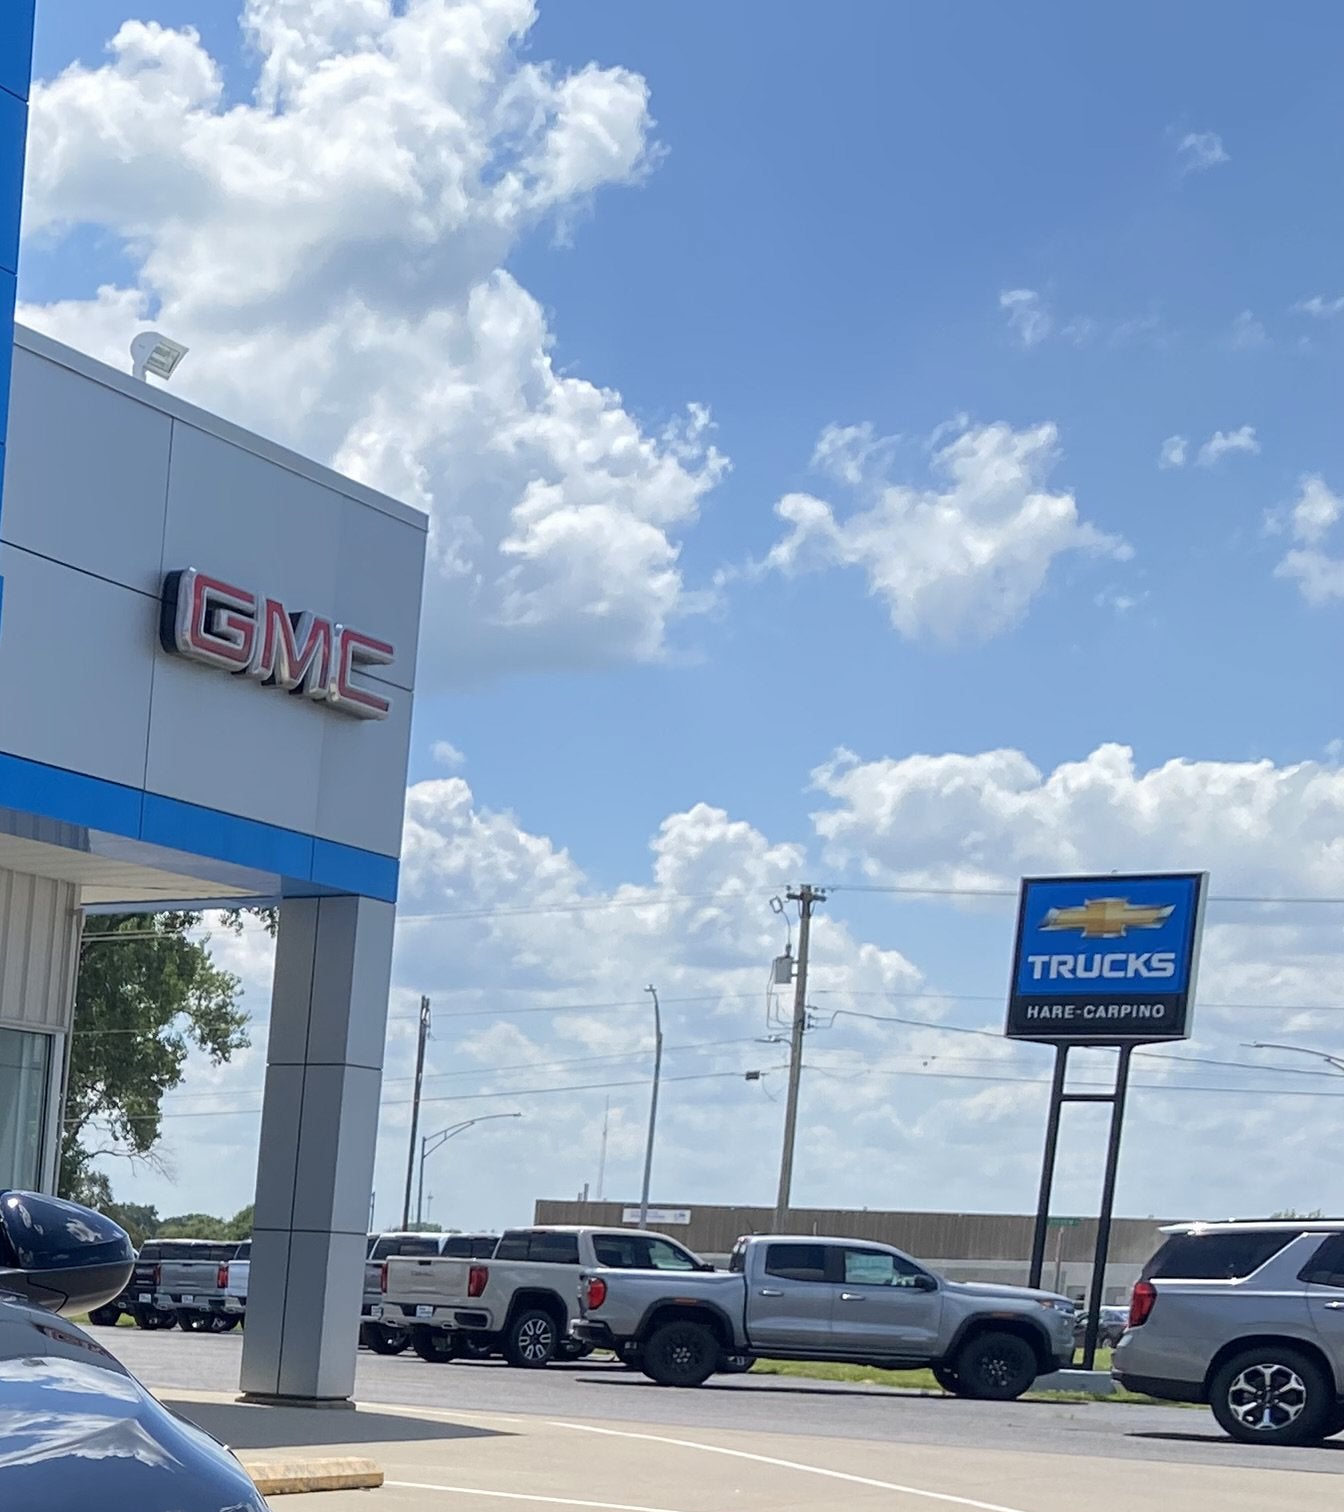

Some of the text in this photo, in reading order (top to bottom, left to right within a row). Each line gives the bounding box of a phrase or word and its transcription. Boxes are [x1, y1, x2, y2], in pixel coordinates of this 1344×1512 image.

[162, 567, 395, 720] GMC
[1027, 952, 1176, 980] TRUCKS
[1026, 1004, 1166, 1019] HARE-CARPINO
